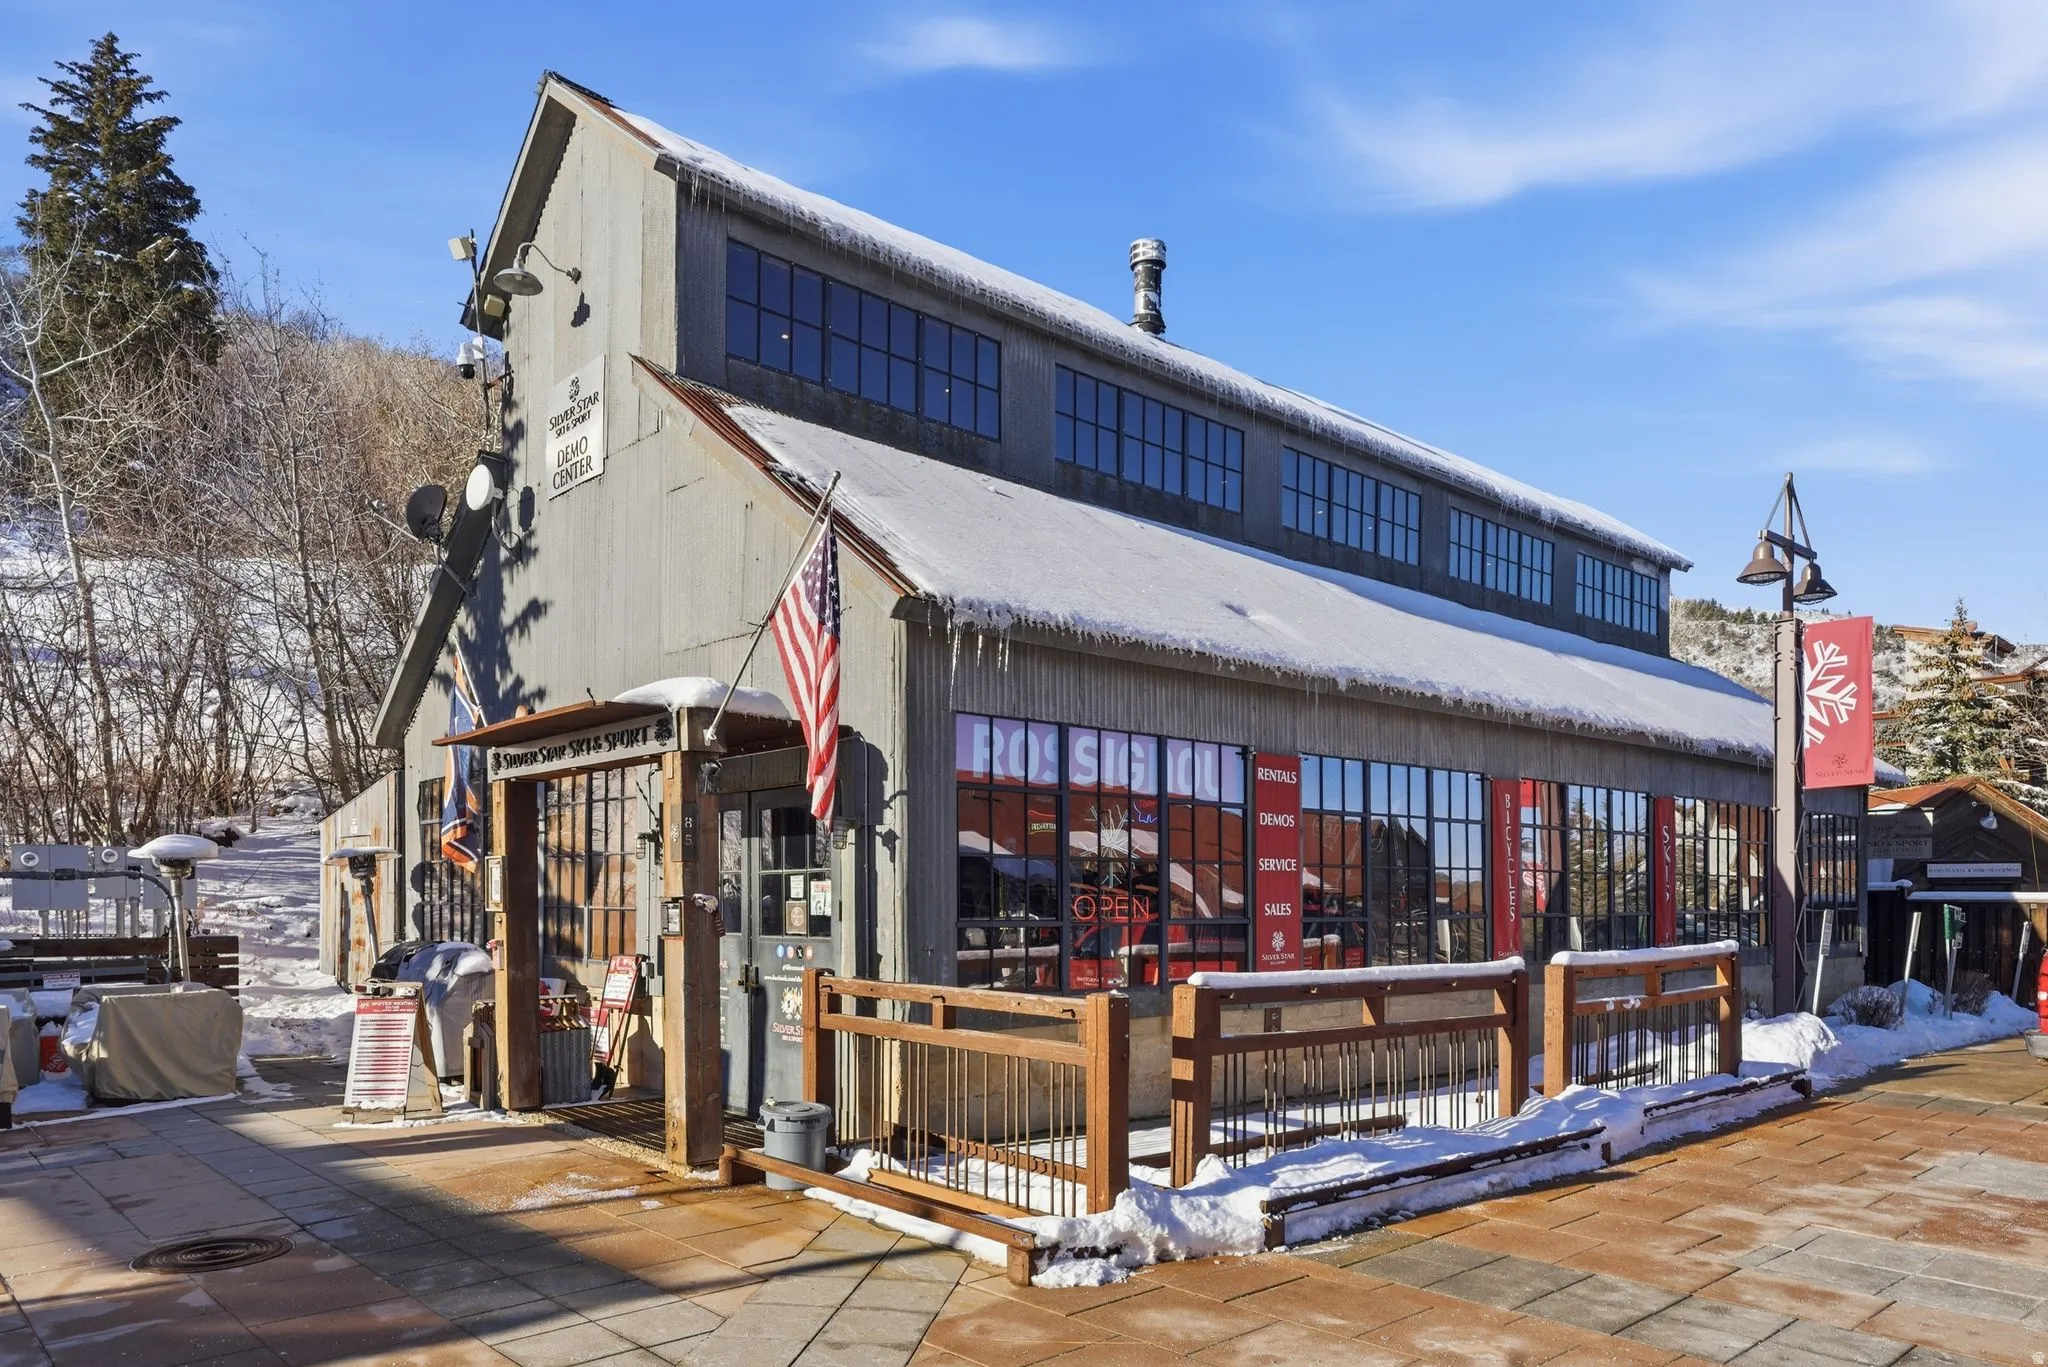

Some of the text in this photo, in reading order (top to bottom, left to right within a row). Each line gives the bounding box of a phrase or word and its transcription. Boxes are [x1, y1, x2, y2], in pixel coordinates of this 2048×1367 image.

[549, 391, 600, 431] SILVER STAR
[555, 425, 566, 439] SKI
[571, 409, 592, 429] SPORT
[557, 435, 588, 468] DEMO
[552, 455, 593, 490] CENTER
[503, 750, 540, 770] SILVER
[538, 746, 567, 764] STAR
[568, 738, 592, 759] SKI
[603, 725, 651, 752] SPORT
[1257, 767, 1297, 784] RENTALS
[1259, 812, 1295, 827] DEMOS
[1258, 857, 1297, 871] SERVICE
[1504, 793, 1516, 922] BICYCLES
[1074, 895, 1150, 920] OPEN
[1264, 903, 1292, 916] SALES
[772, 1022, 796, 1035] SILVER
